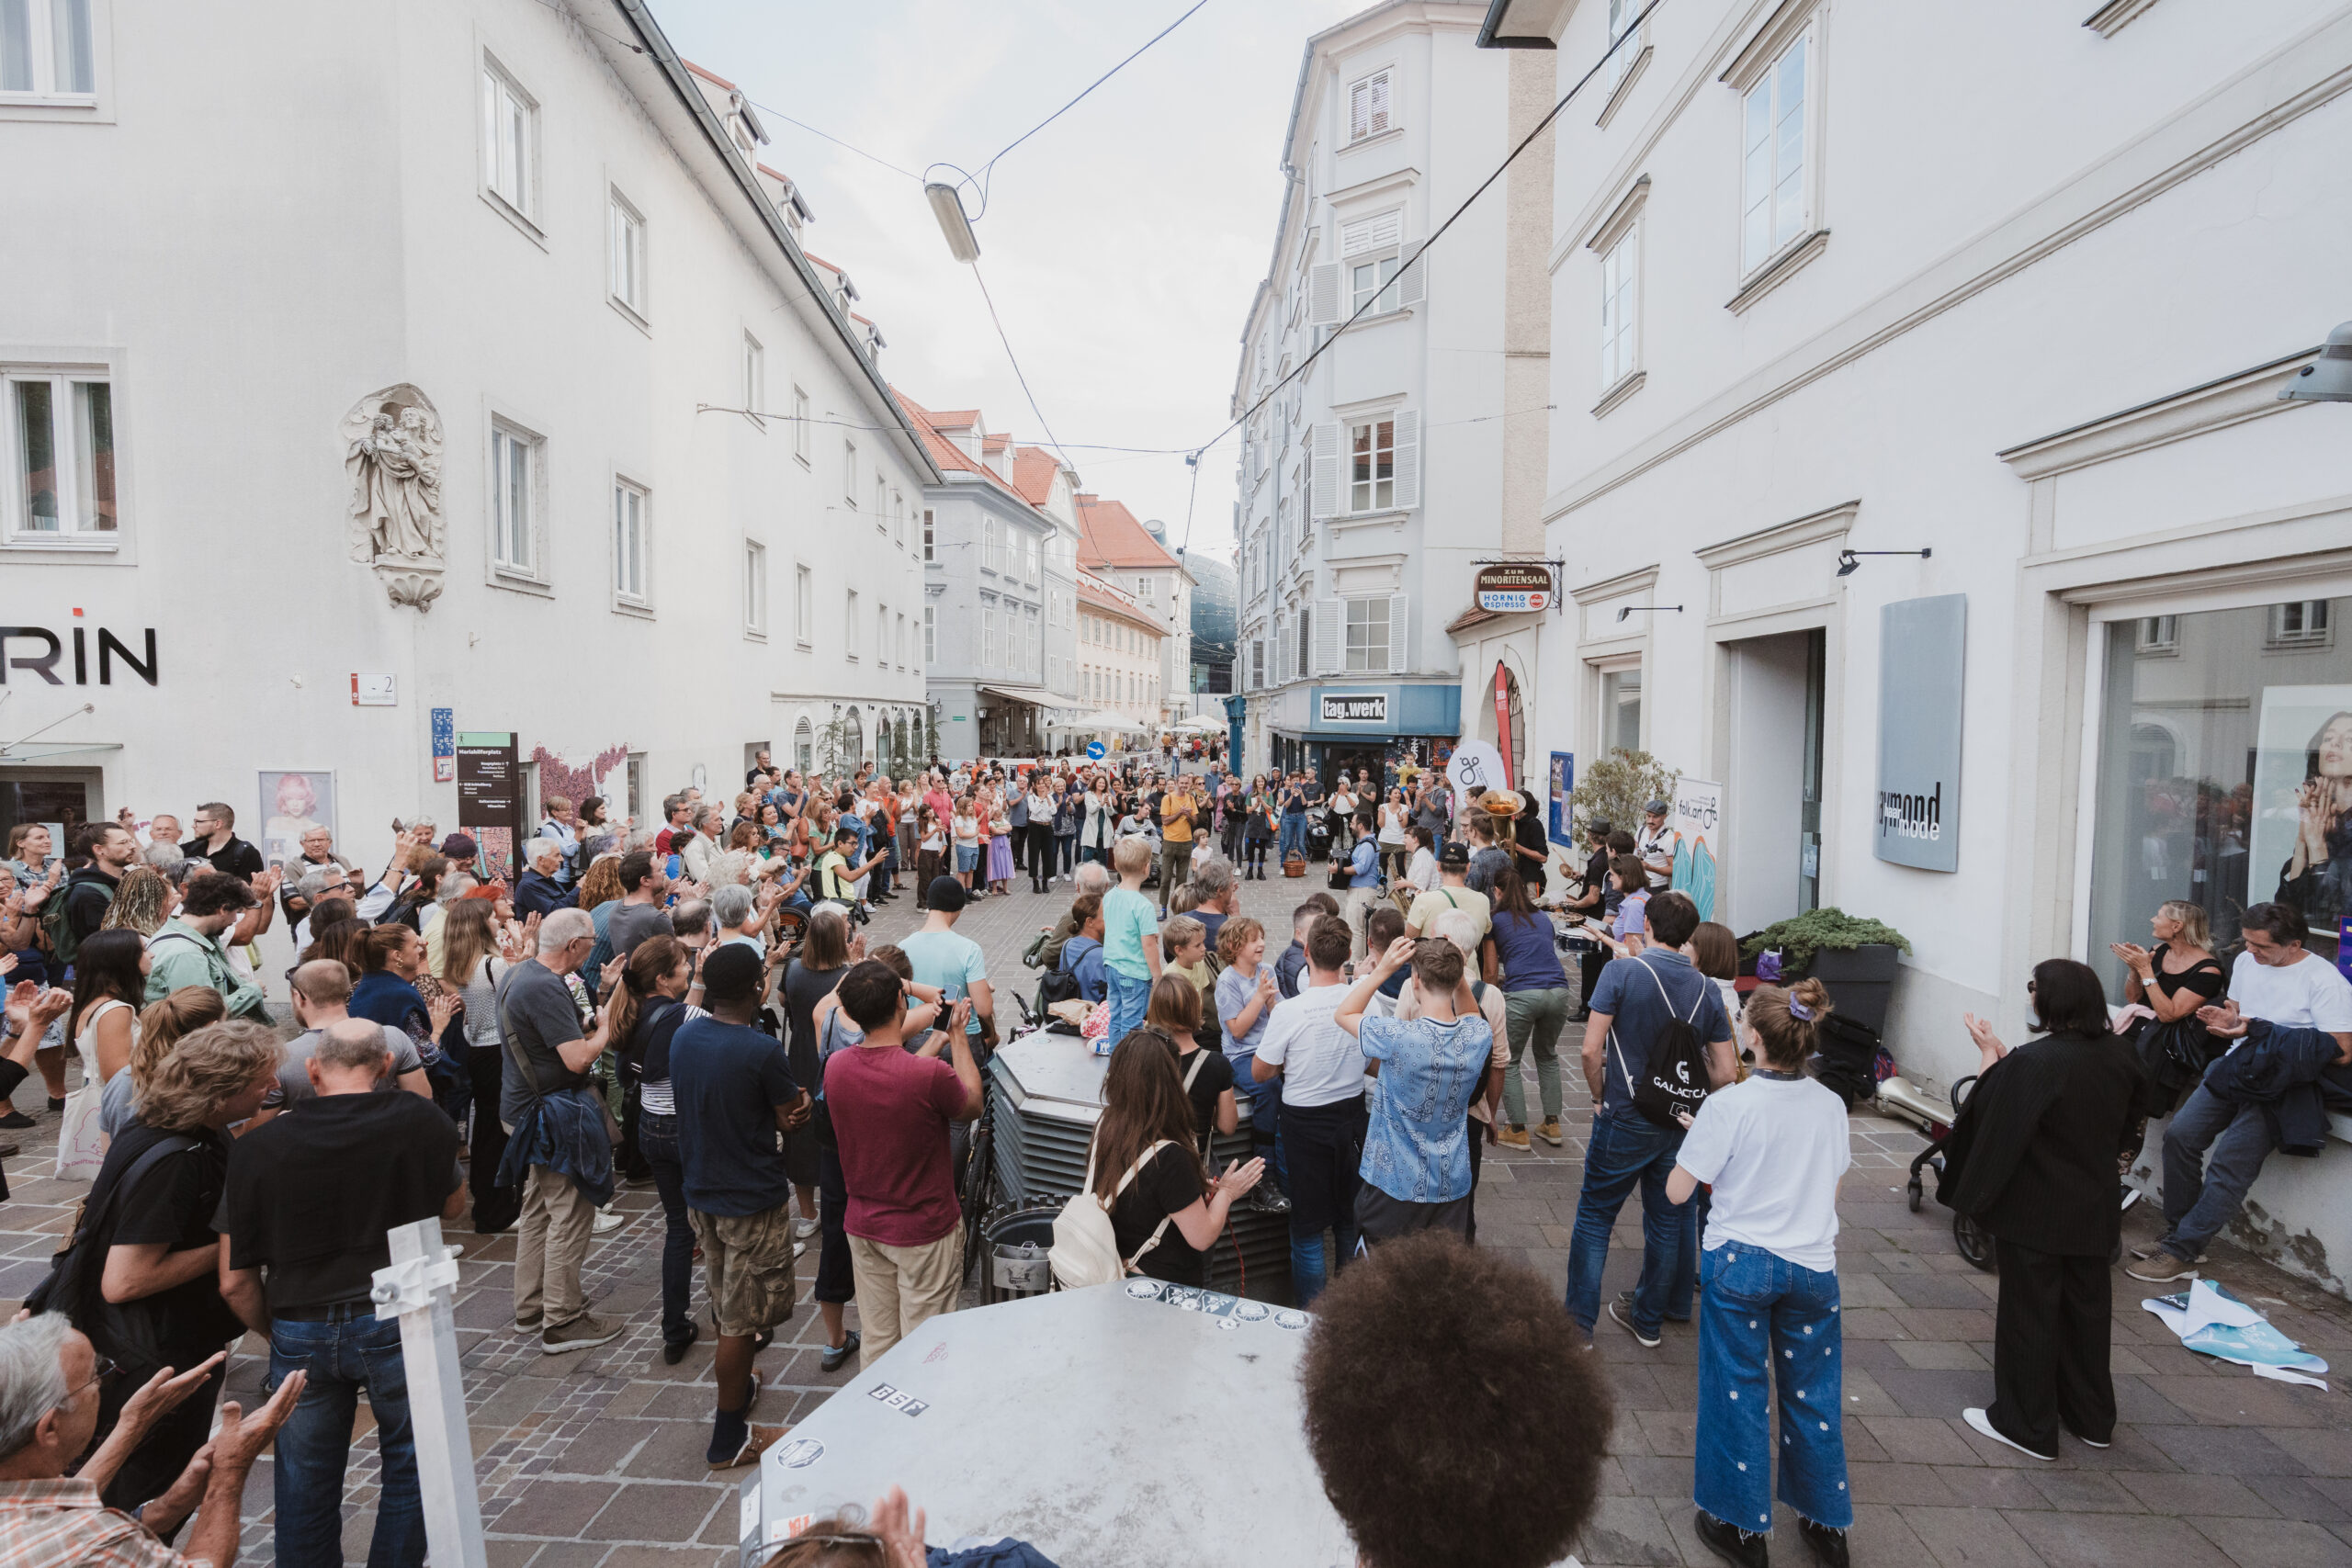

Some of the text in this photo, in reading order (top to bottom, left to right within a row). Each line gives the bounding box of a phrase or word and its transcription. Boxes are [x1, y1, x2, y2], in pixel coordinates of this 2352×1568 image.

[1480, 575, 1549, 584] MINORITENSAAL
[384, 676, 393, 693] 2
[1324, 698, 1385, 719] tag.werk
[1884, 802, 1902, 819] haar
[1898, 814, 1940, 840] mode
[1653, 1076, 1707, 1099] GALACTCA
